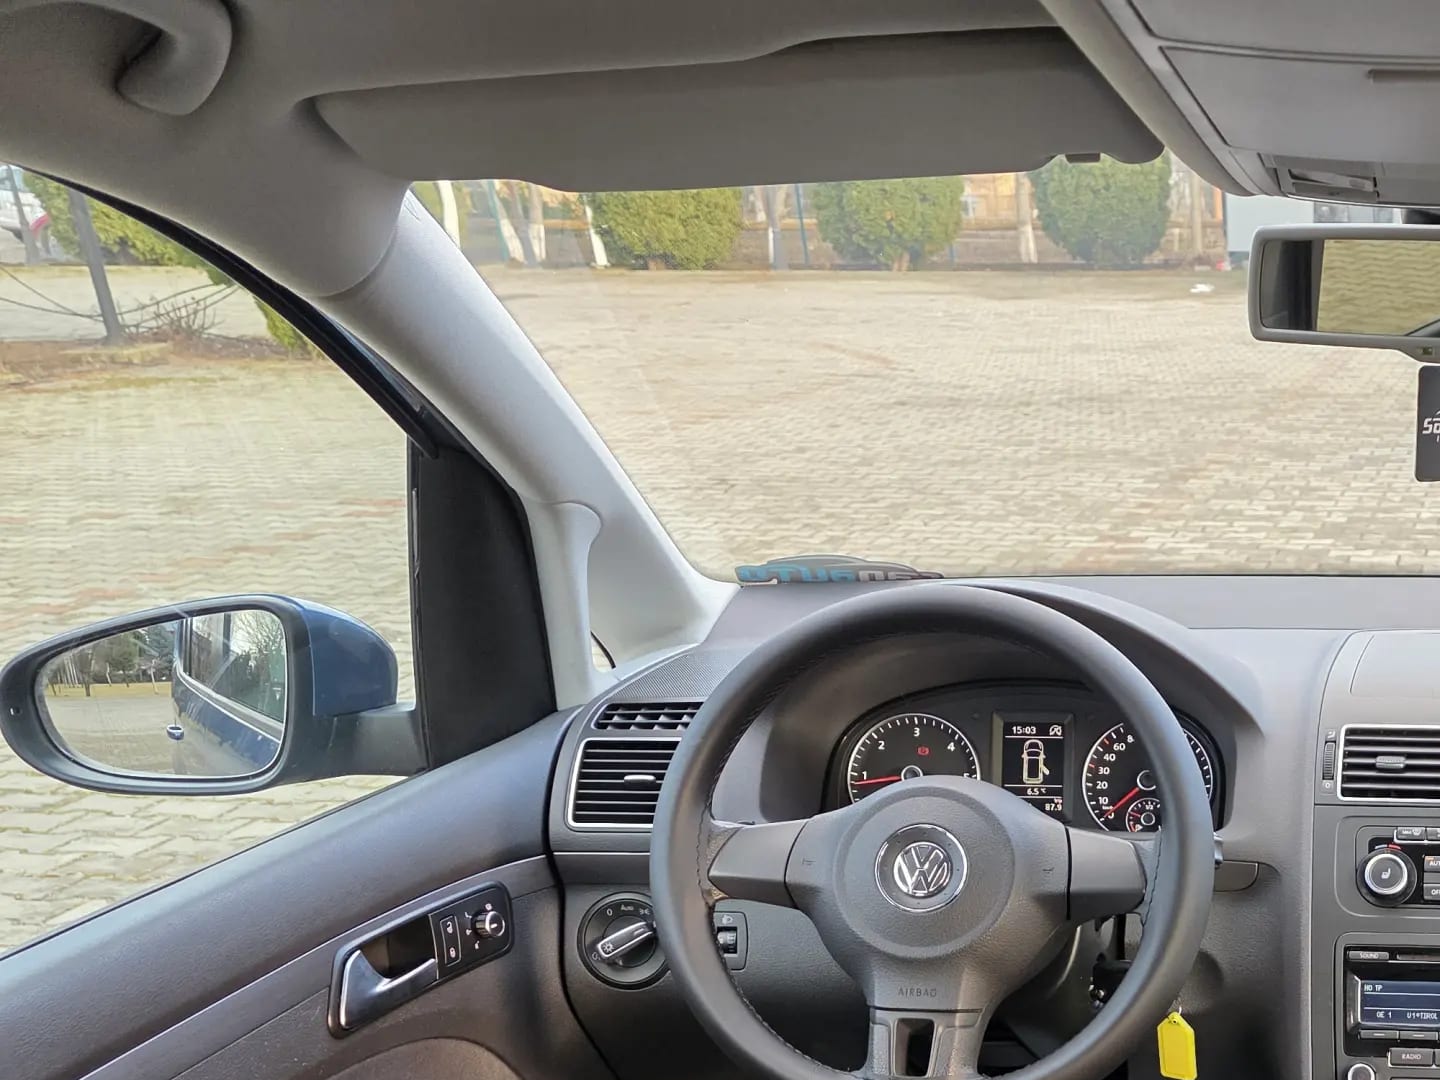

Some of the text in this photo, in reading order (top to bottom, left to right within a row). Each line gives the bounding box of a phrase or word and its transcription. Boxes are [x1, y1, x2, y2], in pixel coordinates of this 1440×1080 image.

[913, 727, 921, 737] 3
[1011, 725, 1037, 735] 15:03
[1127, 734, 1135, 743] 8
[878, 740, 886, 750] 2
[947, 741, 956, 752] 4
[1113, 742, 1126, 751] 60
[1103, 753, 1116, 761] 40
[862, 770, 867, 780] 1
[1098, 766, 1110, 775] 30
[1096, 781, 1108, 789] 20
[1026, 787, 1040, 796] 6.5
[1098, 796, 1109, 805] 10
[1044, 802, 1063, 812] 87.9
[606, 908, 613, 916] 0
[897, 987, 938, 998] AIRBAG
[1375, 984, 1383, 992] TP
